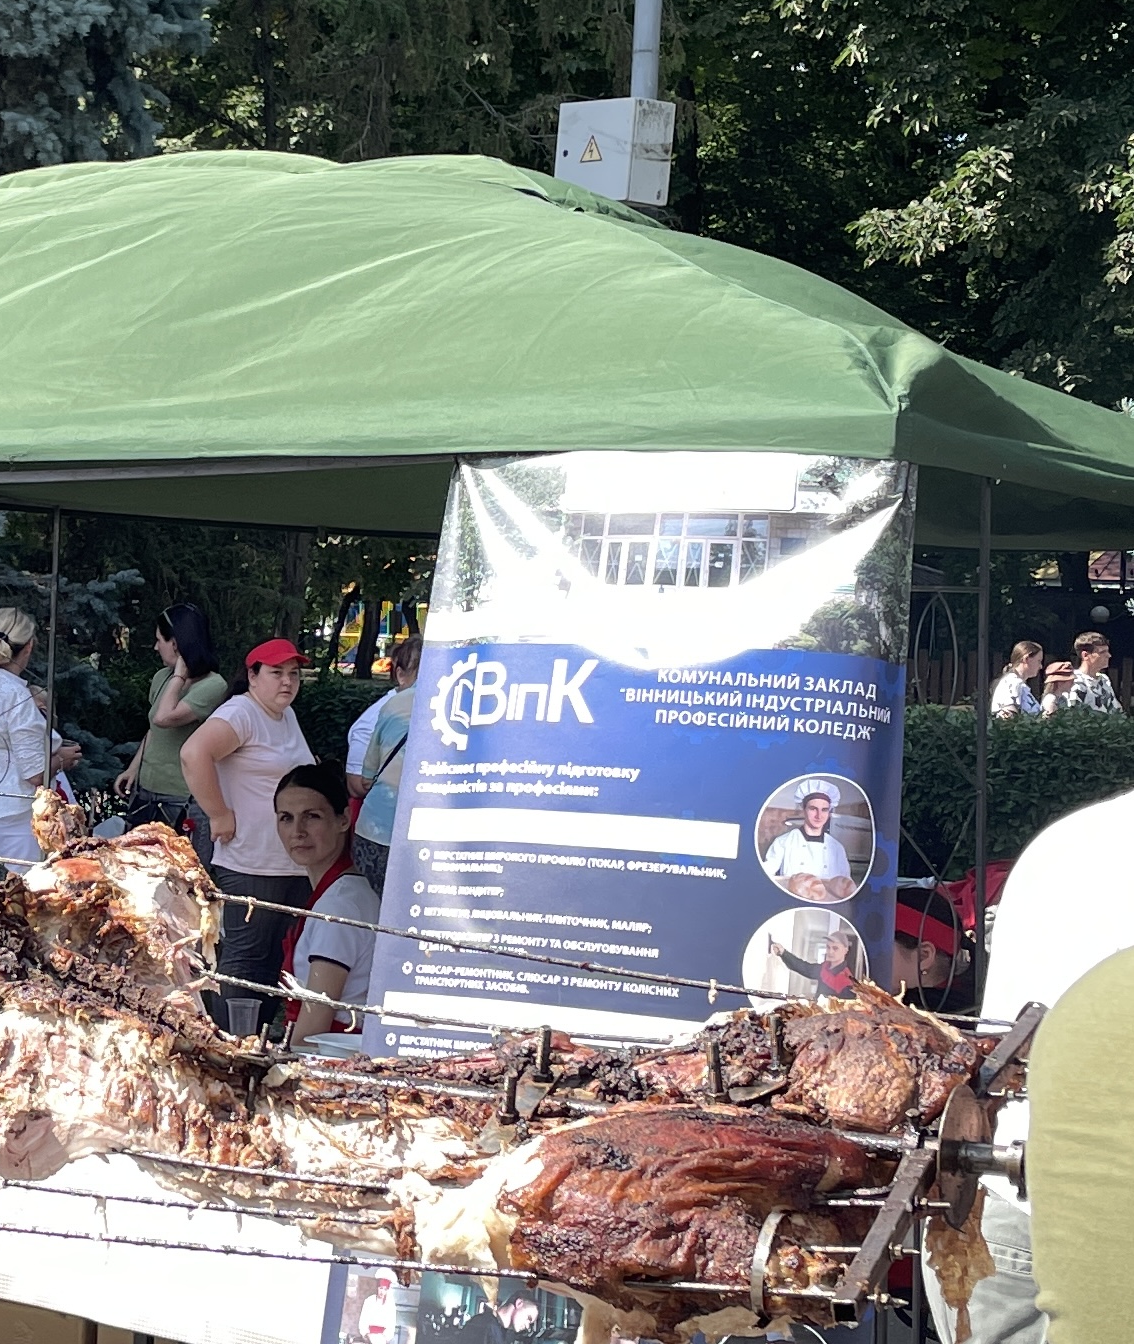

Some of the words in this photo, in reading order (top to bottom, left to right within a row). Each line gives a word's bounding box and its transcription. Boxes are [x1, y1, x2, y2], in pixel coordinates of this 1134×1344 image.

[657, 668, 800, 690] КОМУНАЛЬНИЙ
[803, 676, 877, 702] ЗАКЛАД
[746, 693, 891, 724] ІНДУСТРІАЛЬНИЙ
[655, 709, 789, 732] ПРОФЕСІЙНИЙ
[793, 718, 876, 741] КОЛЕДЖ"
[557, 761, 641, 783] підготовку
[488, 780, 504, 792] за
[506, 780, 599, 797] професіями:
[587, 857, 625, 871] (ТОКАР,
[626, 861, 727, 880] ФРЕЗЕРУВАЛЬНИК,
[611, 920, 653, 935] МАЛЯР;
[500, 935, 547, 948] РЕМОНТУ
[549, 939, 562, 949] ТА
[562, 940, 660, 959] ОБСЛУГОВУВАННЯ
[516, 971, 560, 985] СЛЮСАР
[570, 978, 622, 992] РЕМОНТУ
[623, 984, 680, 998] КОЛІСНИХ
